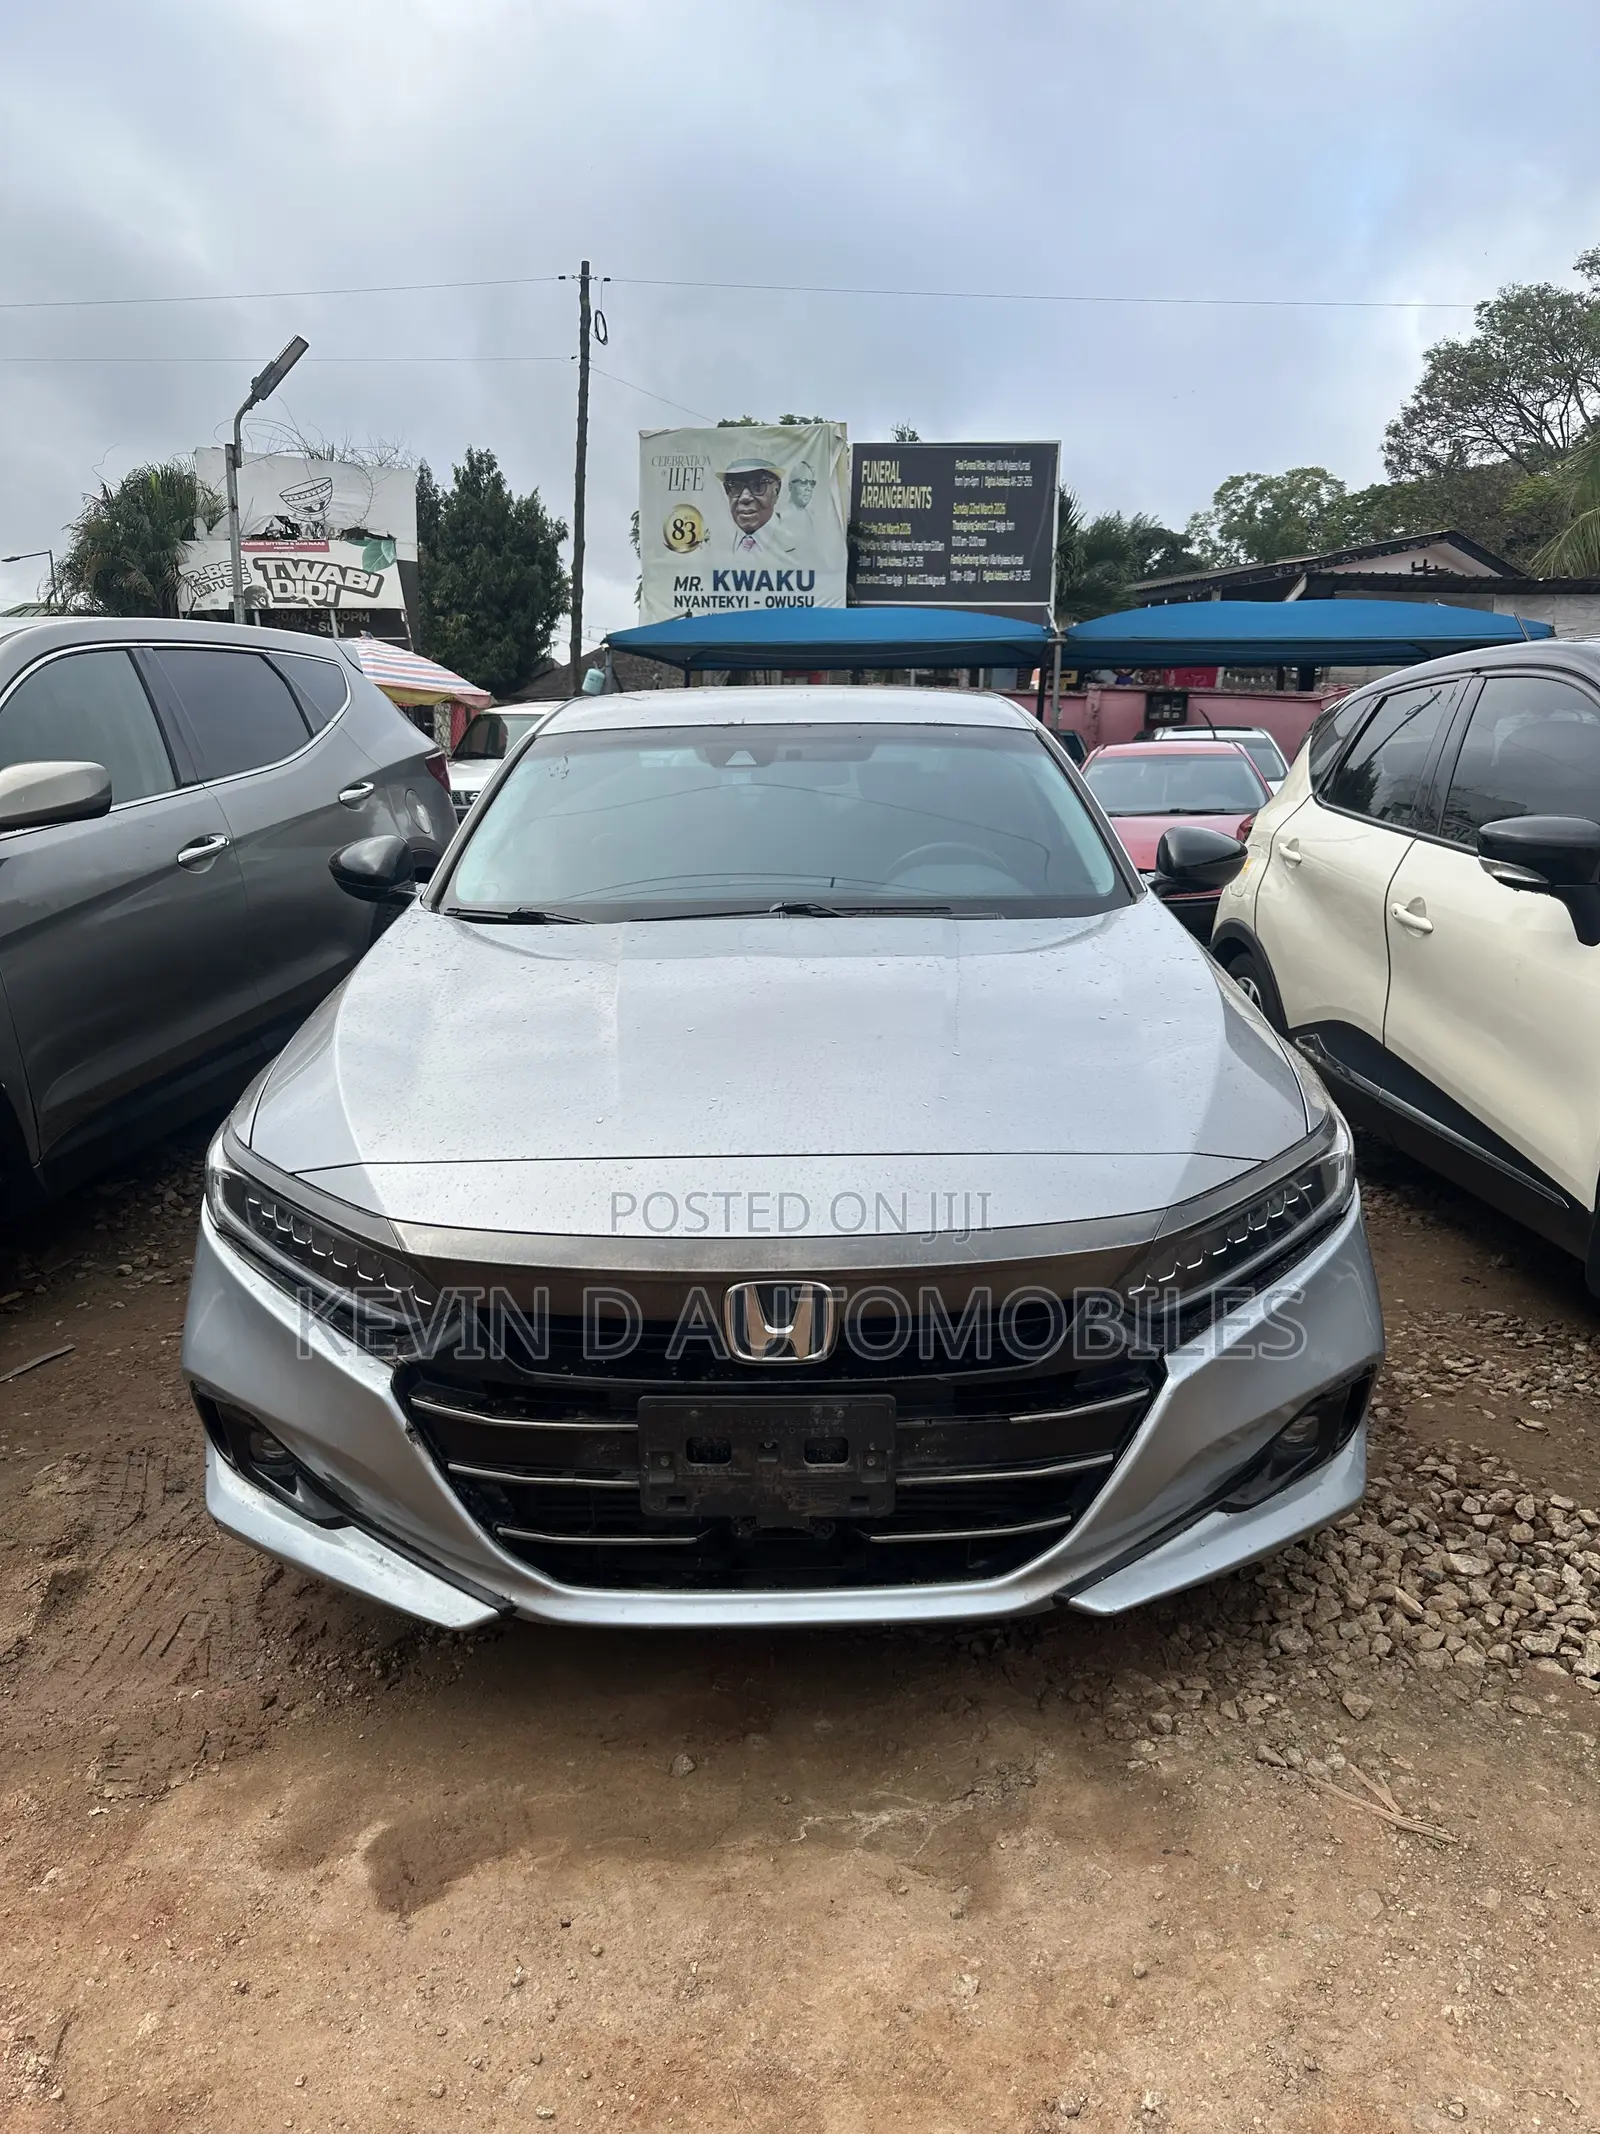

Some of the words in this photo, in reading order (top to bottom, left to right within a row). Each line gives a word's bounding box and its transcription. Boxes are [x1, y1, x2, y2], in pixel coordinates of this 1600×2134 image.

[651, 455, 712, 467] CELEBRATION
[861, 460, 902, 484] FUNERAL
[668, 467, 704, 492] LIFE
[859, 486, 933, 509] ARRANGEMENTS
[672, 518, 697, 545] 83
[193, 572, 252, 597] BITTES
[257, 558, 381, 595] TWABI
[673, 576, 704, 591] MR.
[712, 569, 815, 592] KWAKU
[270, 577, 338, 604] DIDI
[673, 595, 749, 609] NYANTEKYI
[765, 595, 815, 609] OWUSU
[318, 621, 344, 634] SUN
